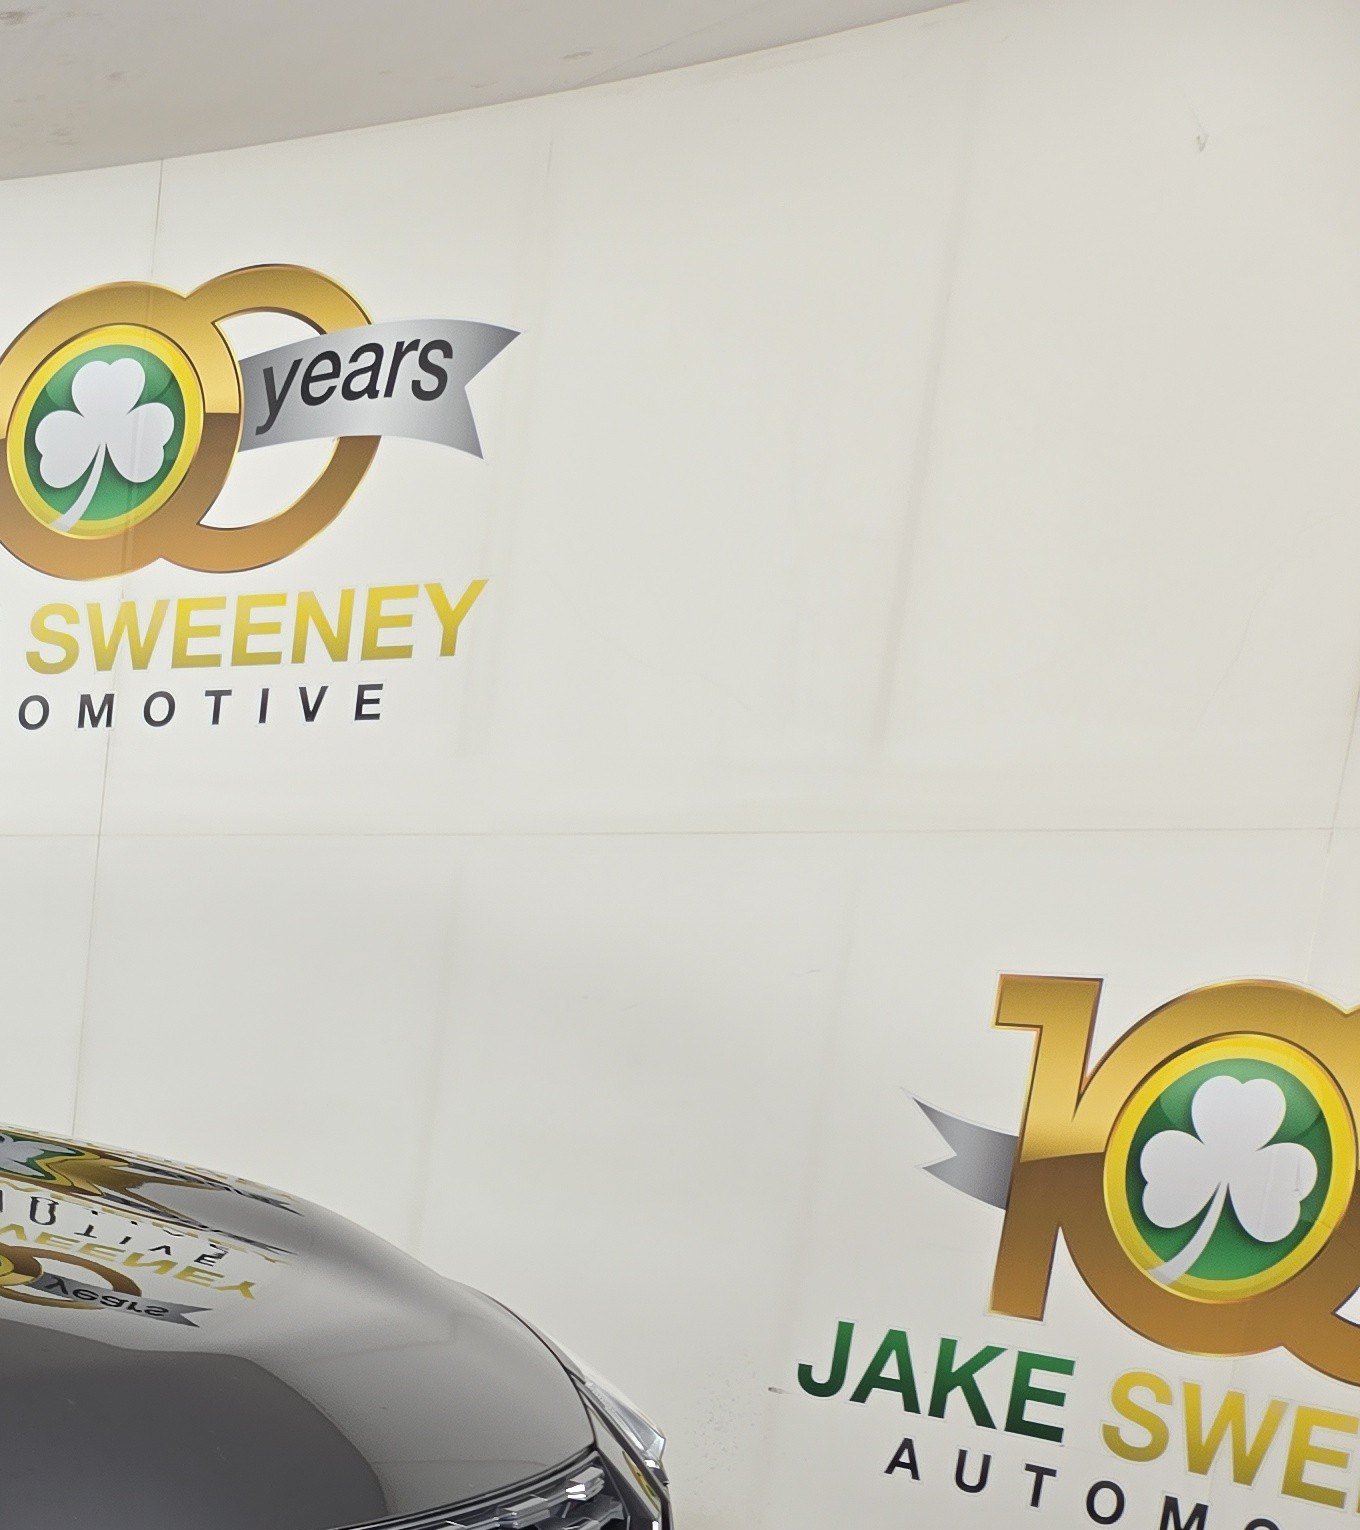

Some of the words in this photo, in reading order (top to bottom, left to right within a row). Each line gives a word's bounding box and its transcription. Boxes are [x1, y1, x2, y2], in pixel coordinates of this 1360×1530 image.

[254, 335, 454, 435] years
[25, 579, 490, 674] SWEENEY
[988, 973, 1360, 1389] 10
[797, 1320, 1076, 1443] JAKE
[1101, 1371, 1360, 1514] SWE
